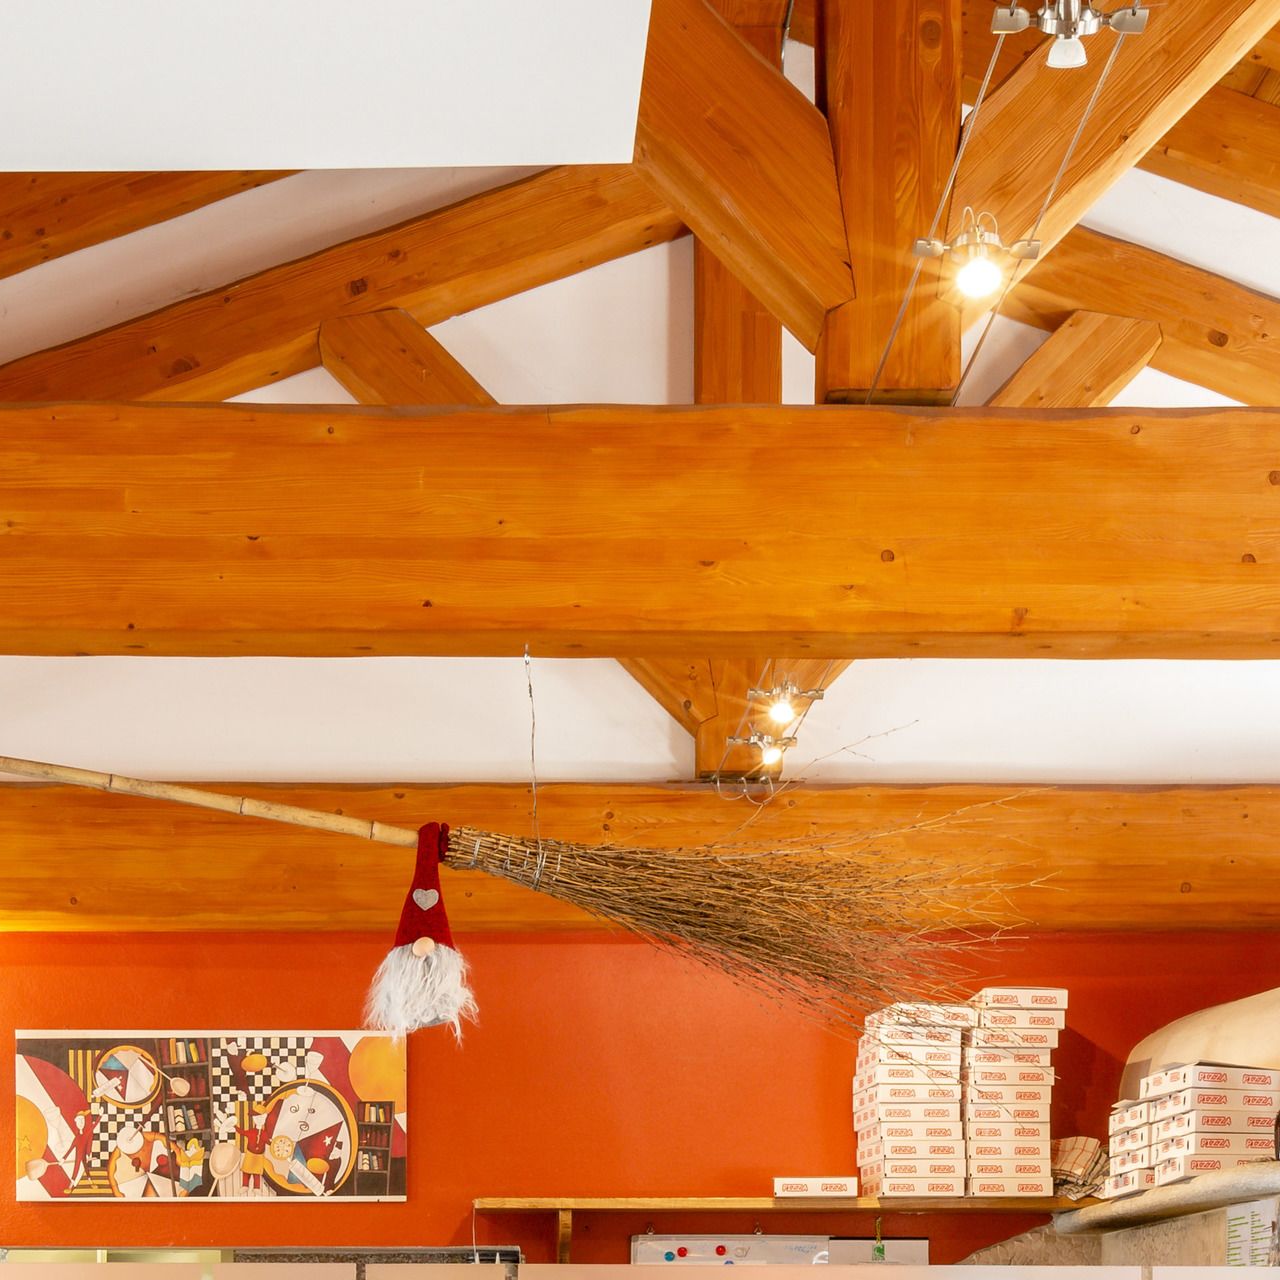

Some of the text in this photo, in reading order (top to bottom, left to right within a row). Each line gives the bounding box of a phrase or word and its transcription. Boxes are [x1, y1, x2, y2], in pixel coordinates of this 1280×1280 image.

[993, 995, 1057, 1004] PIZZA PIZZA
[991, 1016, 1054, 1025] PIZZA PIZZA
[926, 1053, 951, 1061] PIZZA
[975, 1054, 1001, 1062] PIZZA
[889, 1069, 913, 1078] PIZZA
[981, 1072, 1044, 1081] PIZZA PIZZA
[1198, 1072, 1271, 1085] PIZZA PIZZA
[890, 1089, 915, 1097] PIZZA
[978, 1091, 1041, 1100] PIZZA PIZZA
[1198, 1094, 1272, 1106] PIZZA PIZZA
[886, 1109, 949, 1117] PIZZA PIZZA
[975, 1110, 1039, 1118] PIZZA PIZZA
[1202, 1116, 1231, 1126] PIZZA
[1200, 1139, 1230, 1149] PIZZA
[891, 1146, 954, 1154] PIZZA PIZZA
[976, 1147, 1040, 1155] PIZZA PIZZA
[891, 1165, 955, 1173] PIZZA PIZZA
[977, 1165, 1041, 1173] PIZZA PIZZA
[1191, 1160, 1220, 1170] PIZZA
[782, 1184, 847, 1192] PIZZA PIZZA
[889, 1184, 954, 1192] PIZZA PIZZA
[979, 1184, 1043, 1192] PIZZA PIZZA
